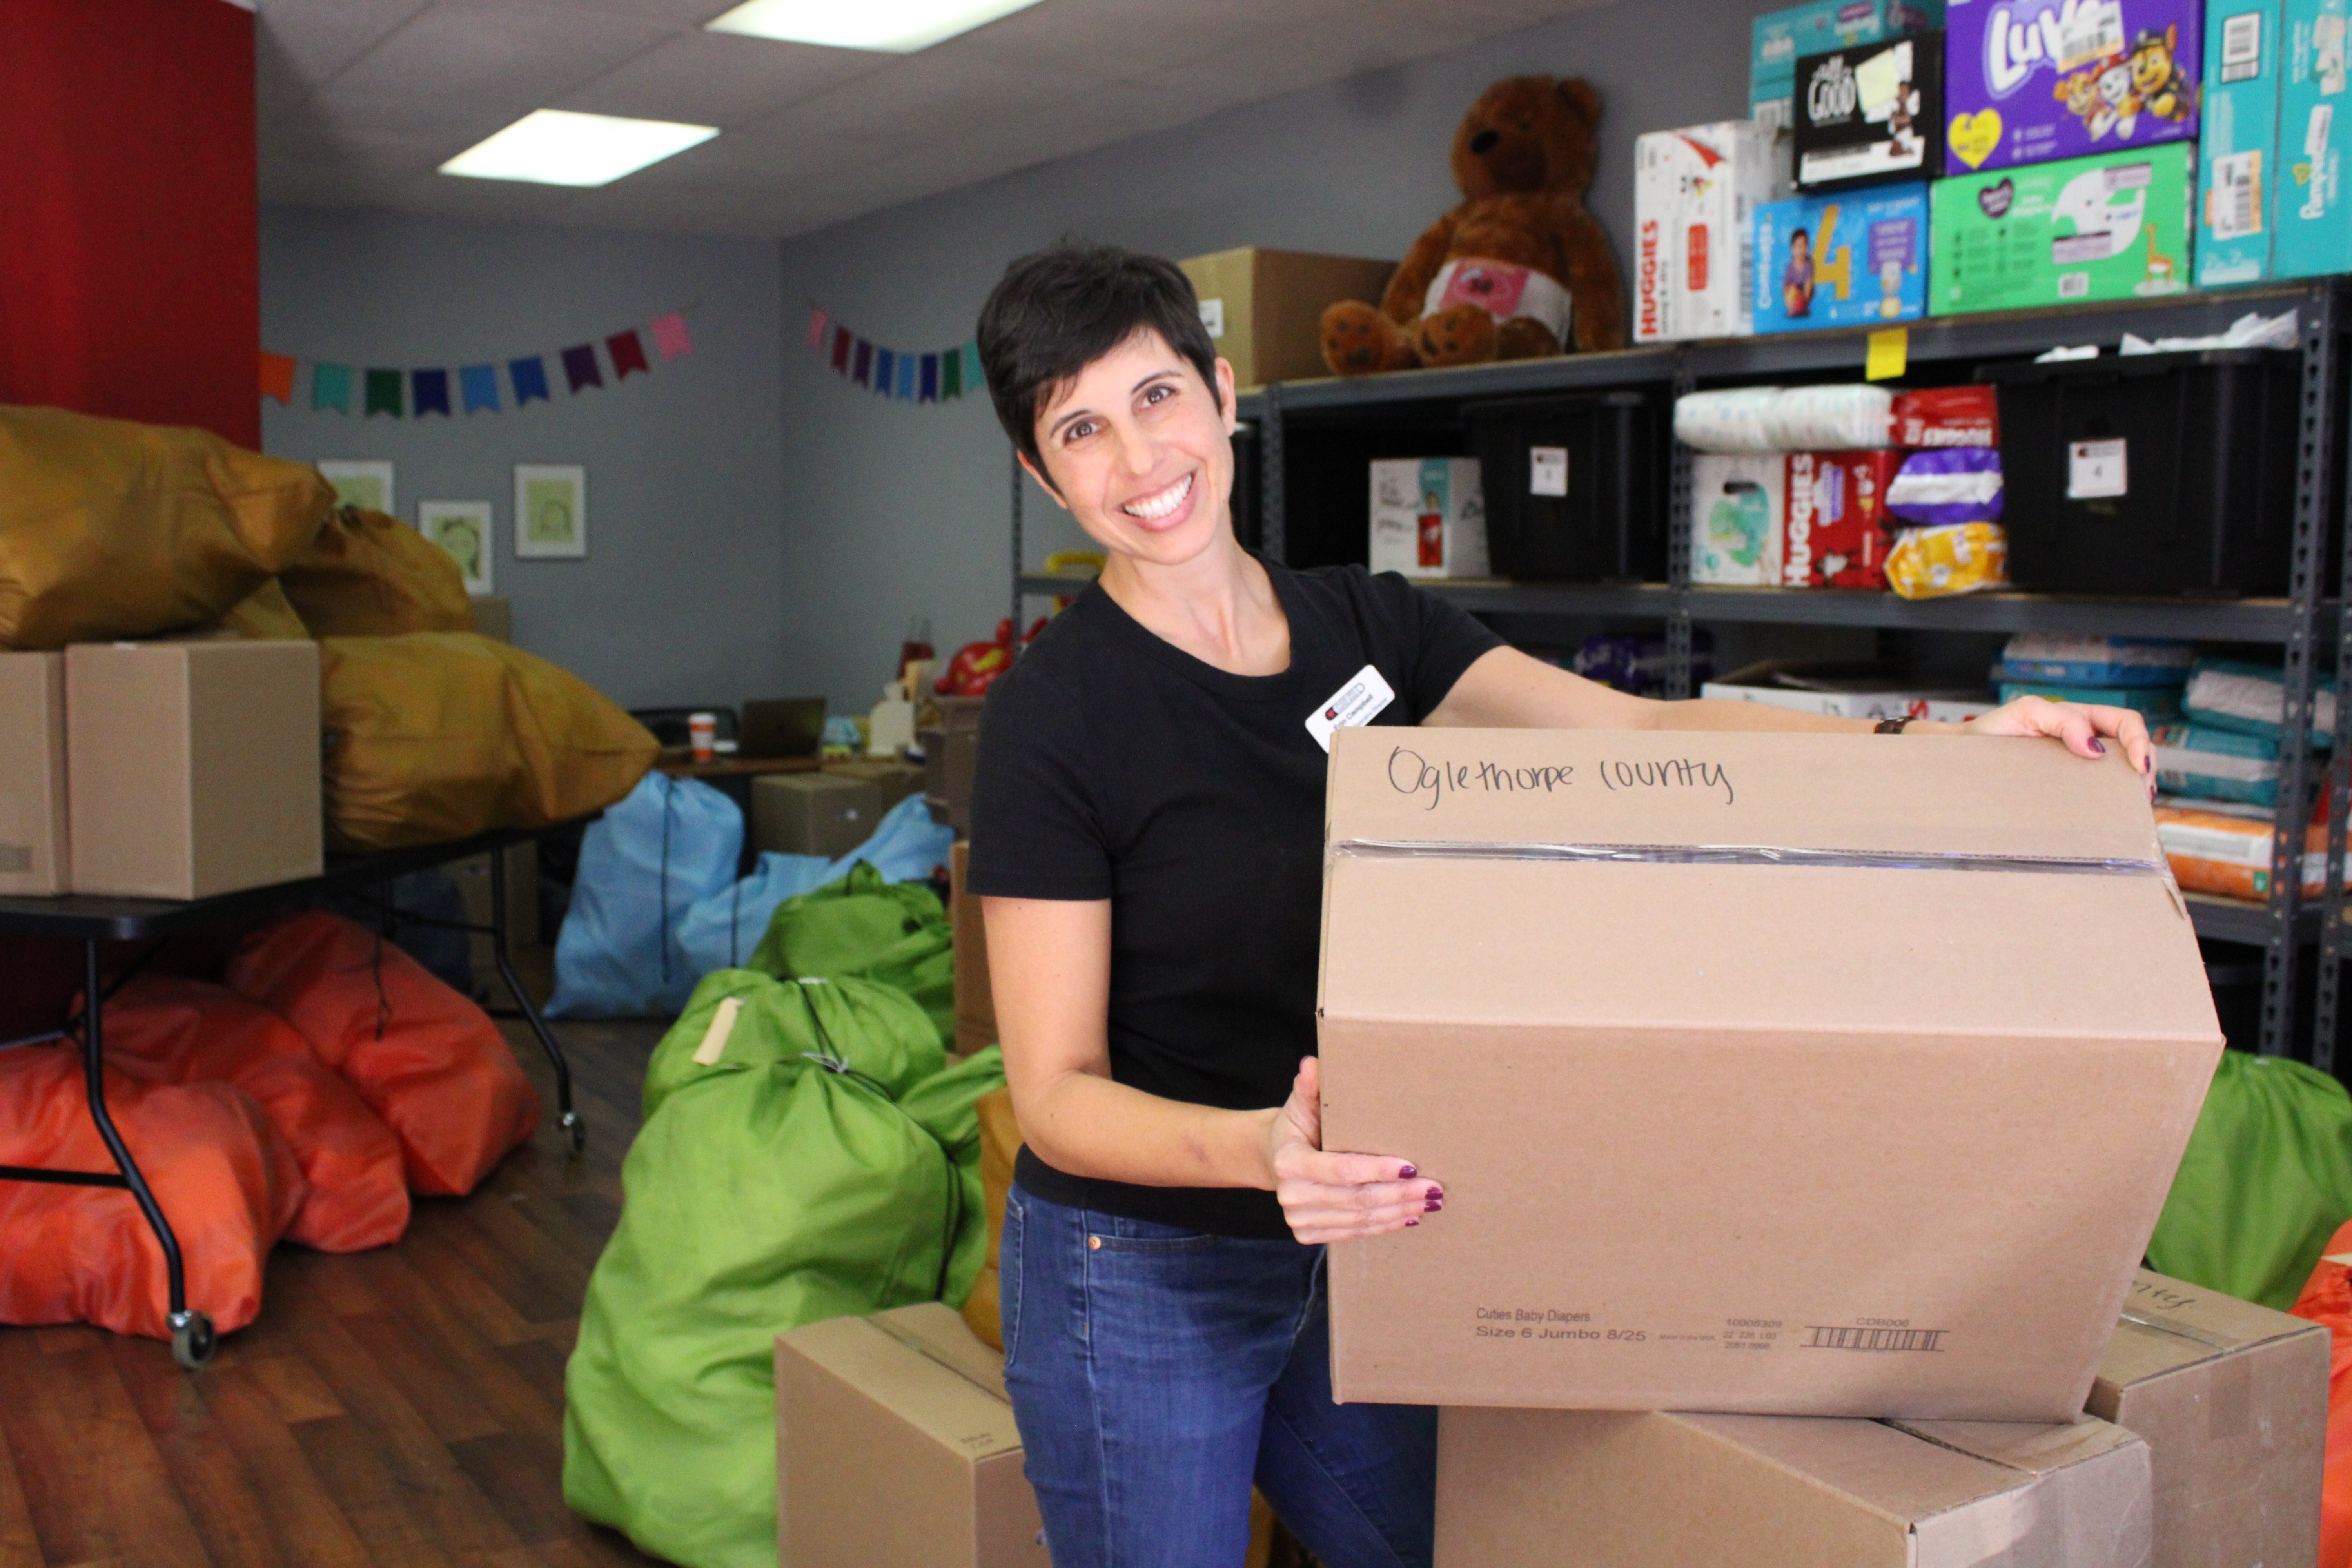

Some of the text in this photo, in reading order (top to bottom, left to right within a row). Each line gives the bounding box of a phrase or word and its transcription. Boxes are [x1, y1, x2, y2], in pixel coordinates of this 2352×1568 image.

[1641, 221, 1657, 334] HUGGIES
[1810, 205, 1851, 300] 4
[1784, 454, 1814, 587] HUGGIES
[1388, 746, 1573, 811] Oglethorpe
[1476, 1307, 1591, 1324] Cuties Baby Diapers
[1476, 1326, 1646, 1341] Size 6 Jumbo 8/25
